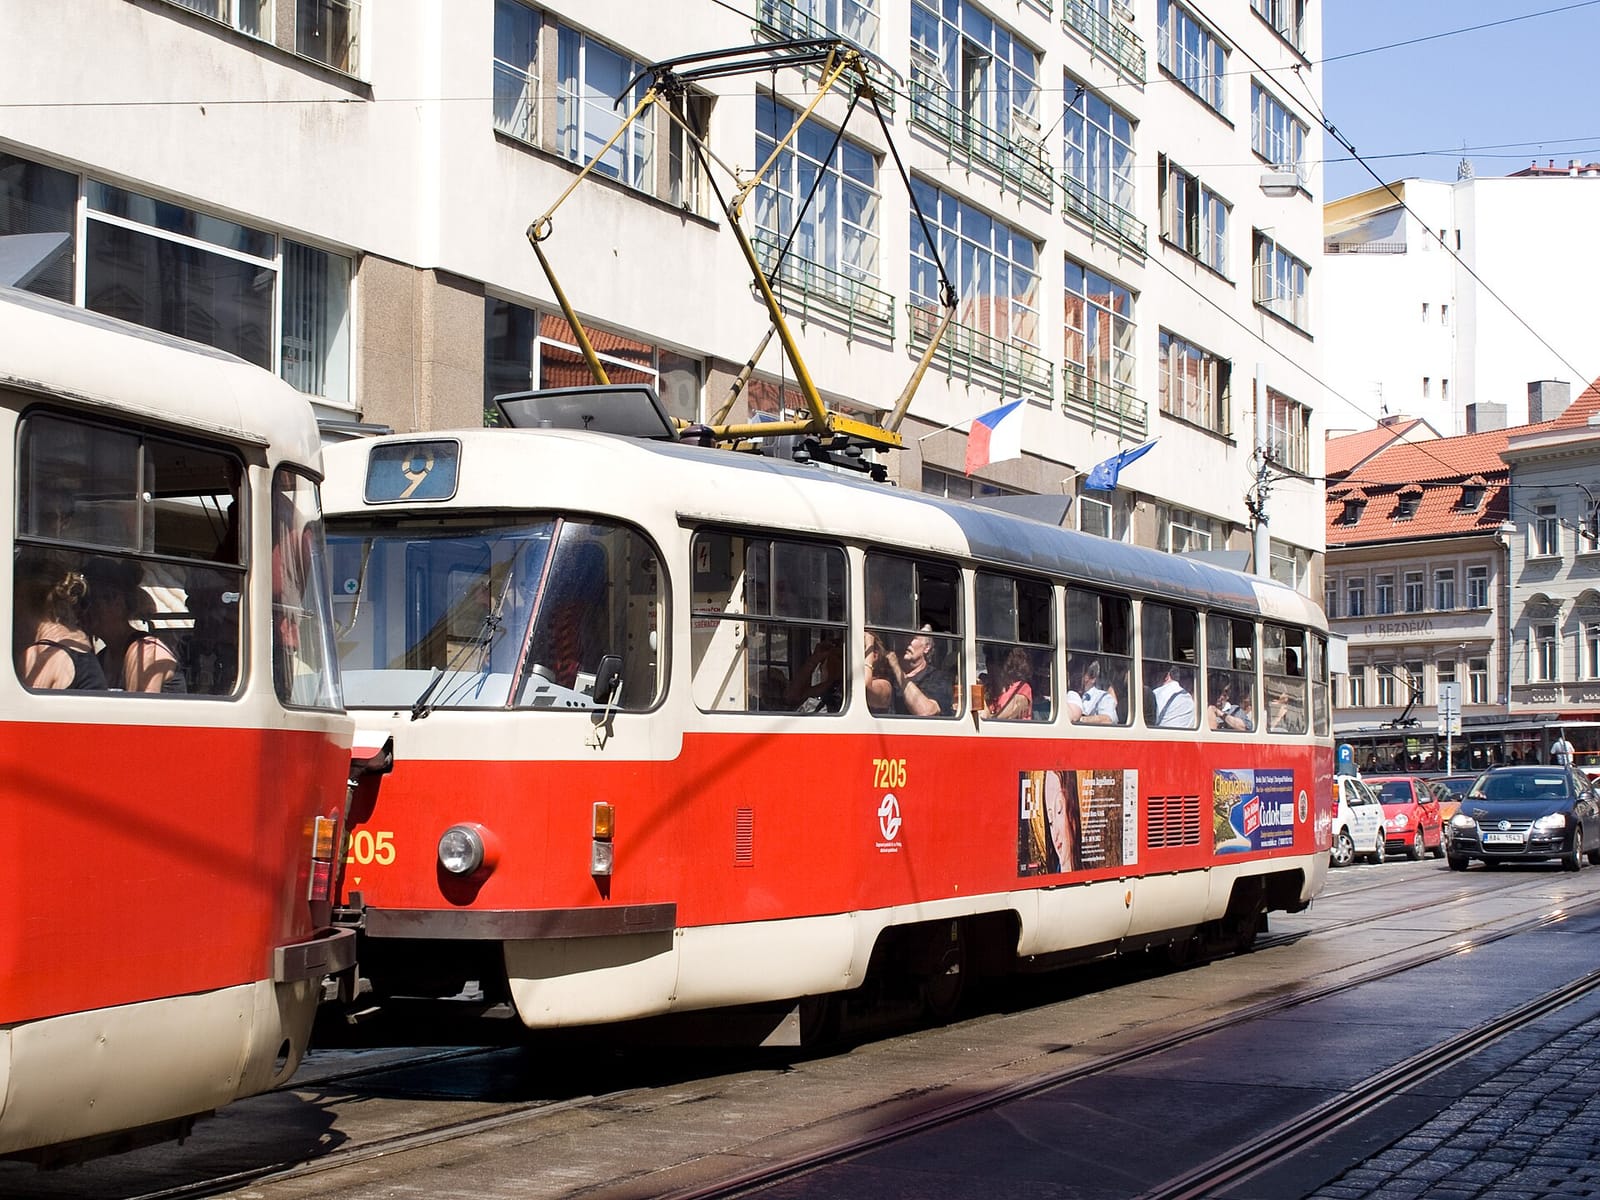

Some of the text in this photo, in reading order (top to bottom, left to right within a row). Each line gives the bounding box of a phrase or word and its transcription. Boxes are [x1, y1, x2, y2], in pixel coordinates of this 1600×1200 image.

[401, 446, 434, 498] 9
[1341, 749, 1350, 760] P
[872, 758, 907, 788] 7205
